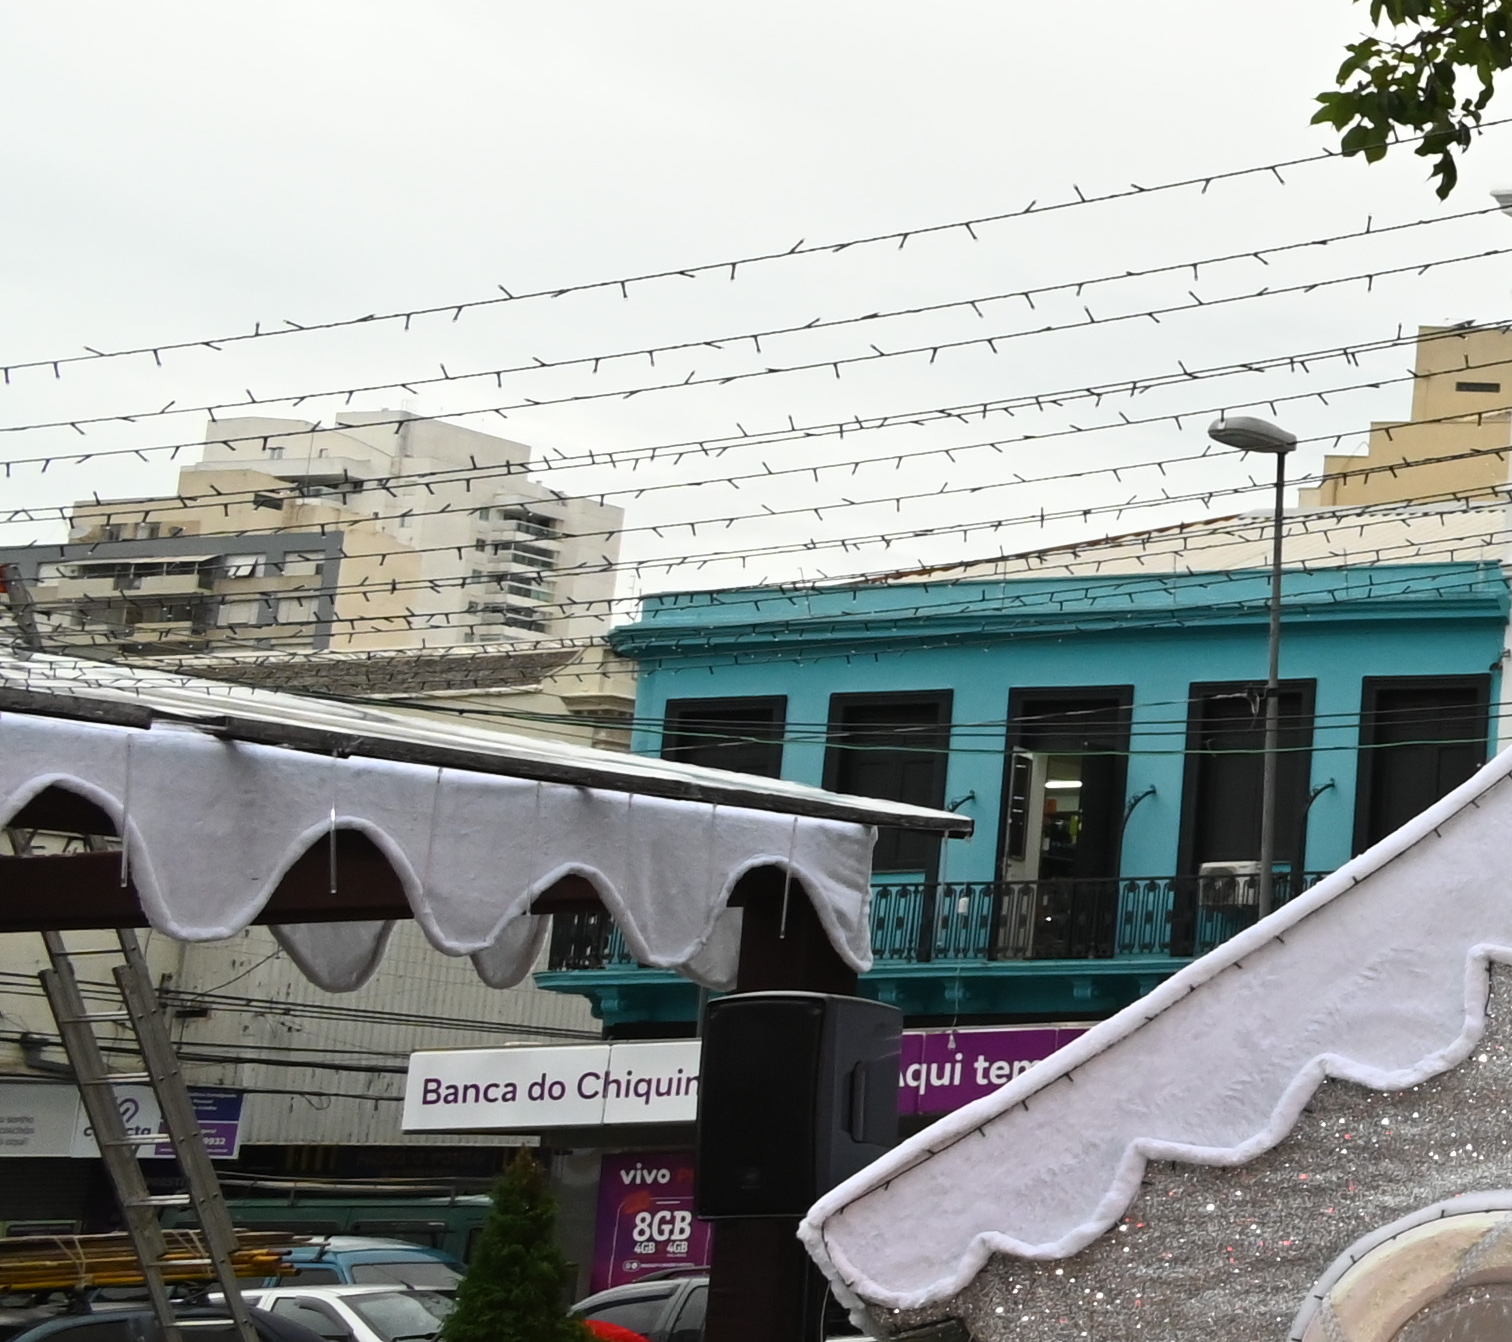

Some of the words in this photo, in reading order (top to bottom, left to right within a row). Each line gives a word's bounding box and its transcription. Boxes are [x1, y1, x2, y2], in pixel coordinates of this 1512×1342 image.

[422, 1078, 518, 1105] Banca
[527, 1073, 566, 1101] do
[620, 1162, 671, 1185] vivo
[632, 1210, 692, 1242] 8GB
[634, 1242, 656, 1254] 4GB
[666, 1241, 688, 1253] 4GB
